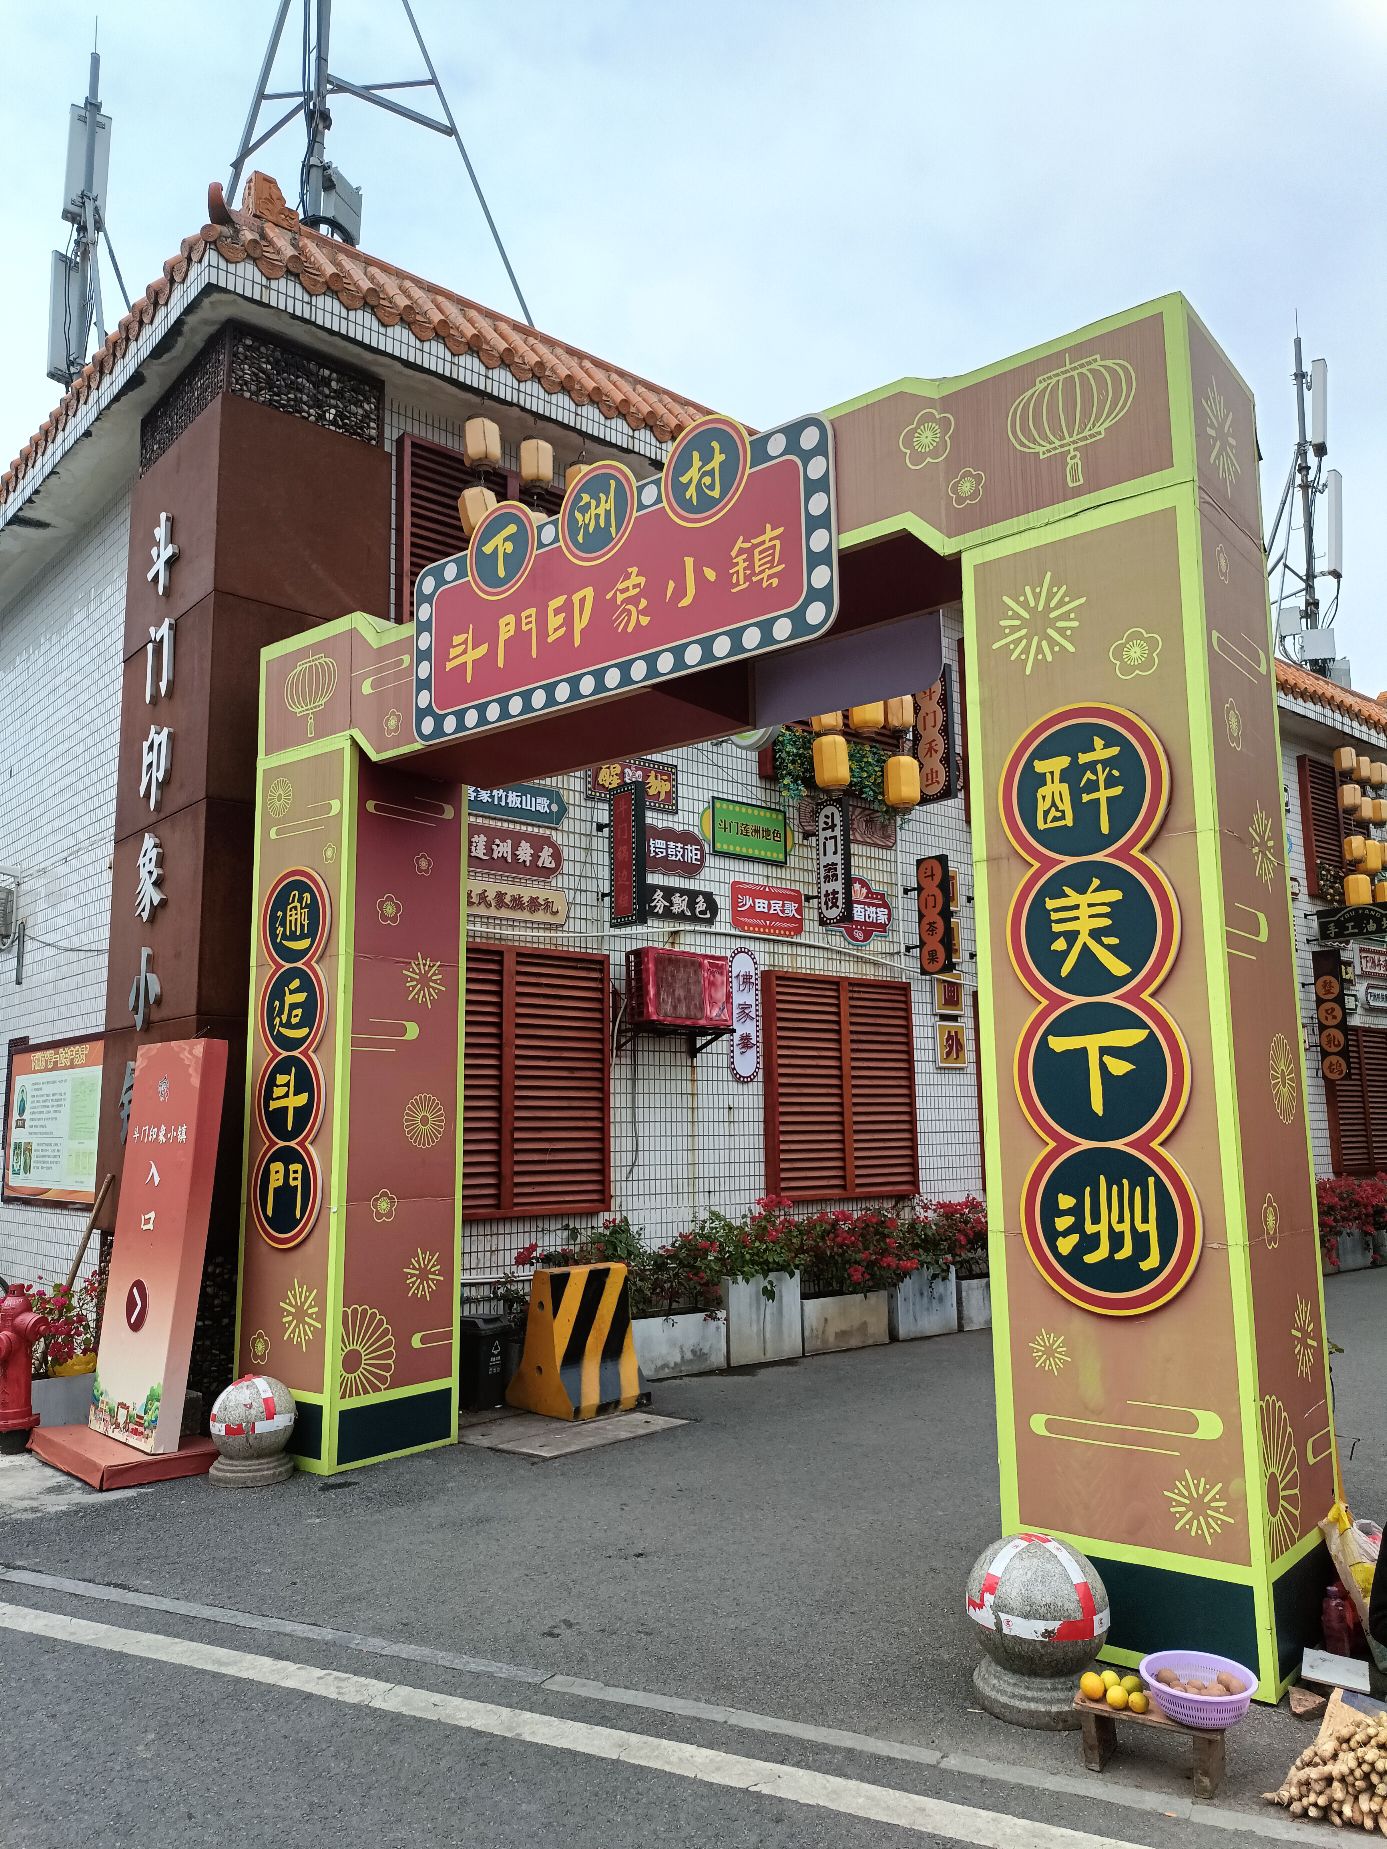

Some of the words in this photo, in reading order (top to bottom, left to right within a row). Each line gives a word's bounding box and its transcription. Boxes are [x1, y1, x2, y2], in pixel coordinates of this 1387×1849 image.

[481, 440, 726, 579] 下洲村
[921, 687, 941, 788] 斗门禾虫
[646, 838, 701, 865] 锣鼓柜
[717, 818, 782, 843] 斗门莲洲地色
[821, 811, 840, 911] 斗门荔枝
[646, 888, 711, 918] 务飘色
[737, 894, 802, 919] 沙田民歌
[923, 866, 939, 965] 斗门茶果
[733, 969, 757, 1056] 佛家拳
[1033, 736, 1160, 1271] 醉美下洲
[1321, 979, 1344, 1076] 整只乳鸽
[140, 1160, 161, 1232] 入口
